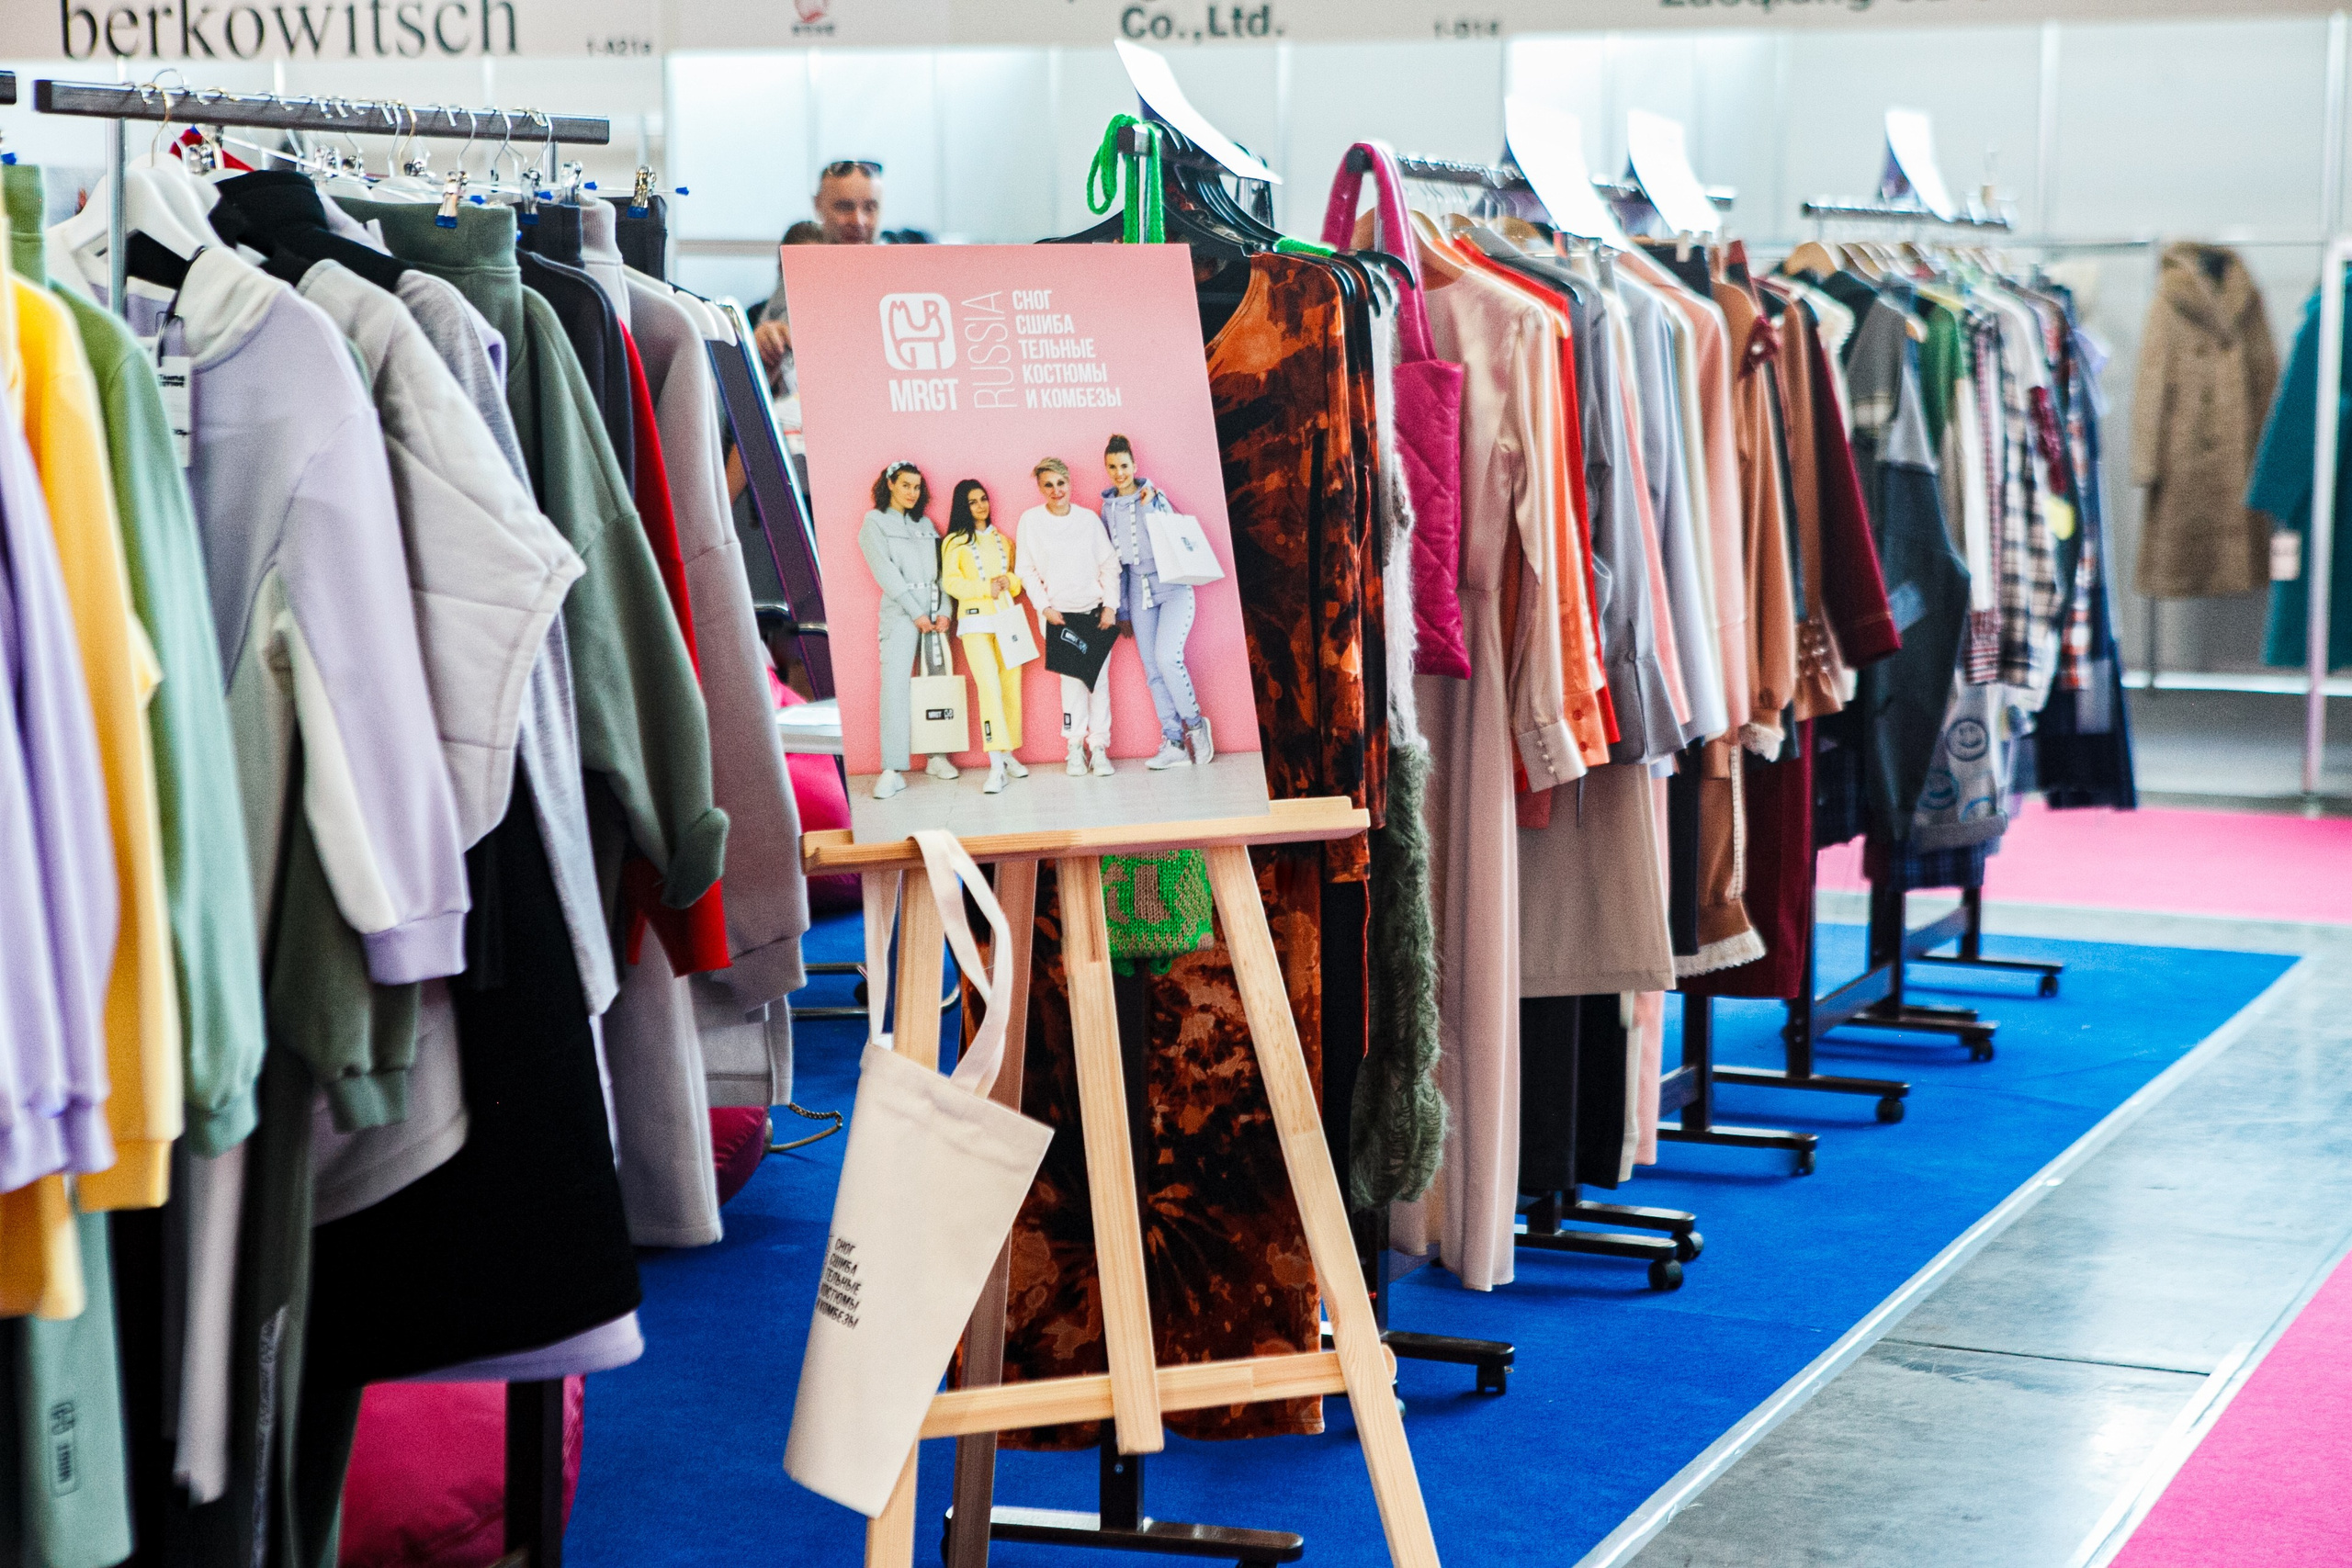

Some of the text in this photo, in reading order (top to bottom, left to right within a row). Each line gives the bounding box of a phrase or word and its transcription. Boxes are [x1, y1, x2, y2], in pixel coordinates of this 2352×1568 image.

[60, 0, 522, 60] berkowitsch
[1012, 289, 1053, 310] СНОГ
[1015, 314, 1075, 335] СШИБА
[961, 290, 1018, 409] RUSSIA
[1018, 338, 1096, 359] ТЕЛЬНЫЕ
[1023, 362, 1108, 384] КОСТЮМЫ
[888, 378, 959, 412] MRGT
[1025, 387, 1123, 409] И КОМБЕЗЫ
